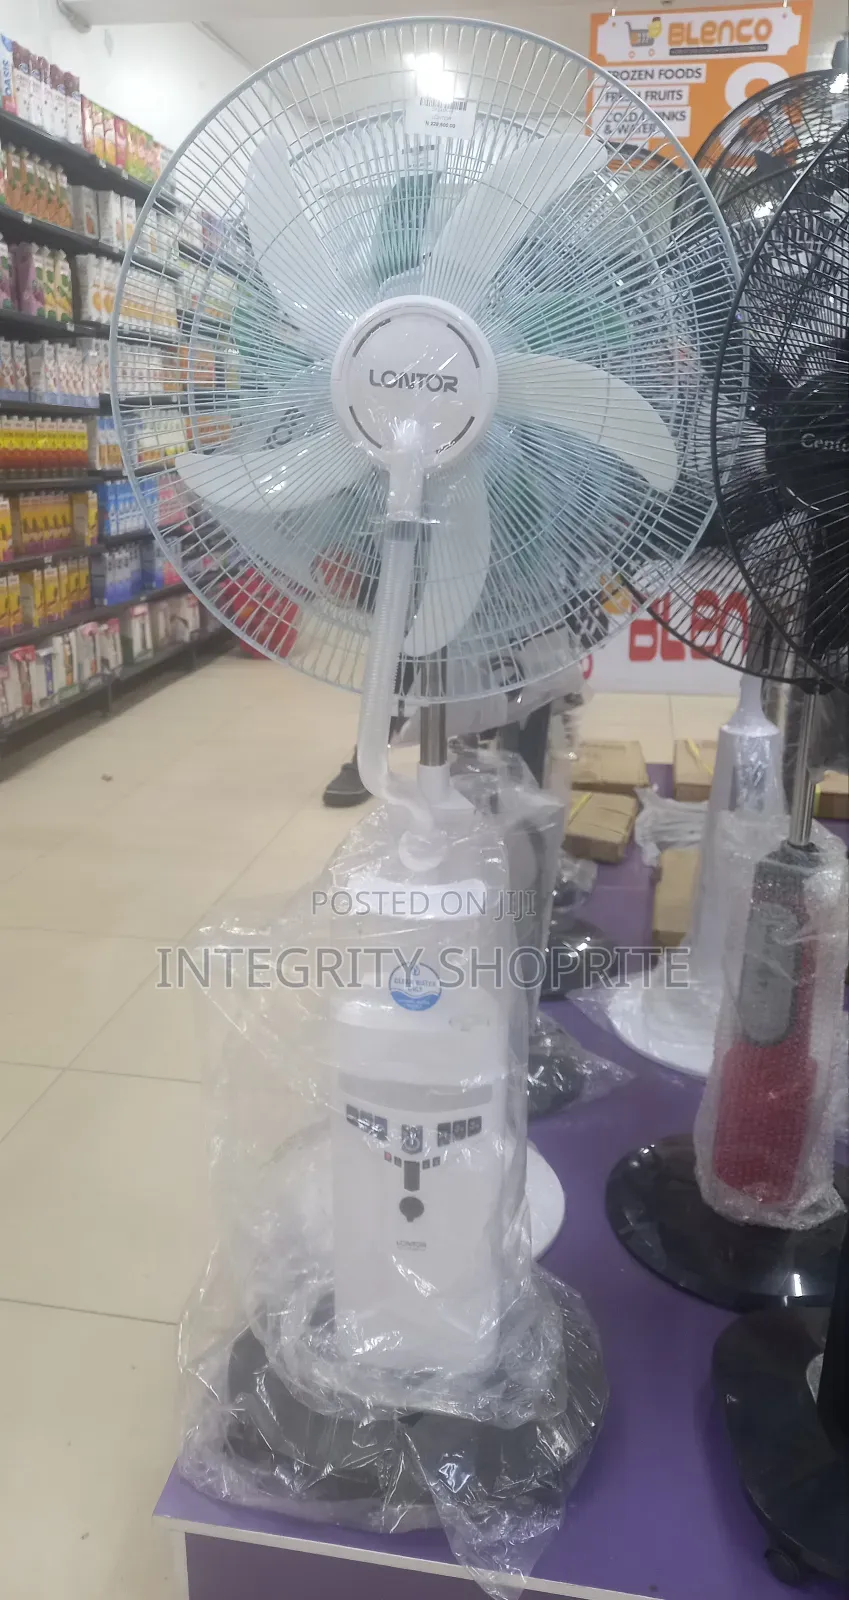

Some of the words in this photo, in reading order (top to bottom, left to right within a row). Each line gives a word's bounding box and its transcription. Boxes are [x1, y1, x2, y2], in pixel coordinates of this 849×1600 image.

[658, 68, 702, 79] FOODS
[645, 90, 683, 101] FRUITS
[369, 369, 458, 393] LONTOR
